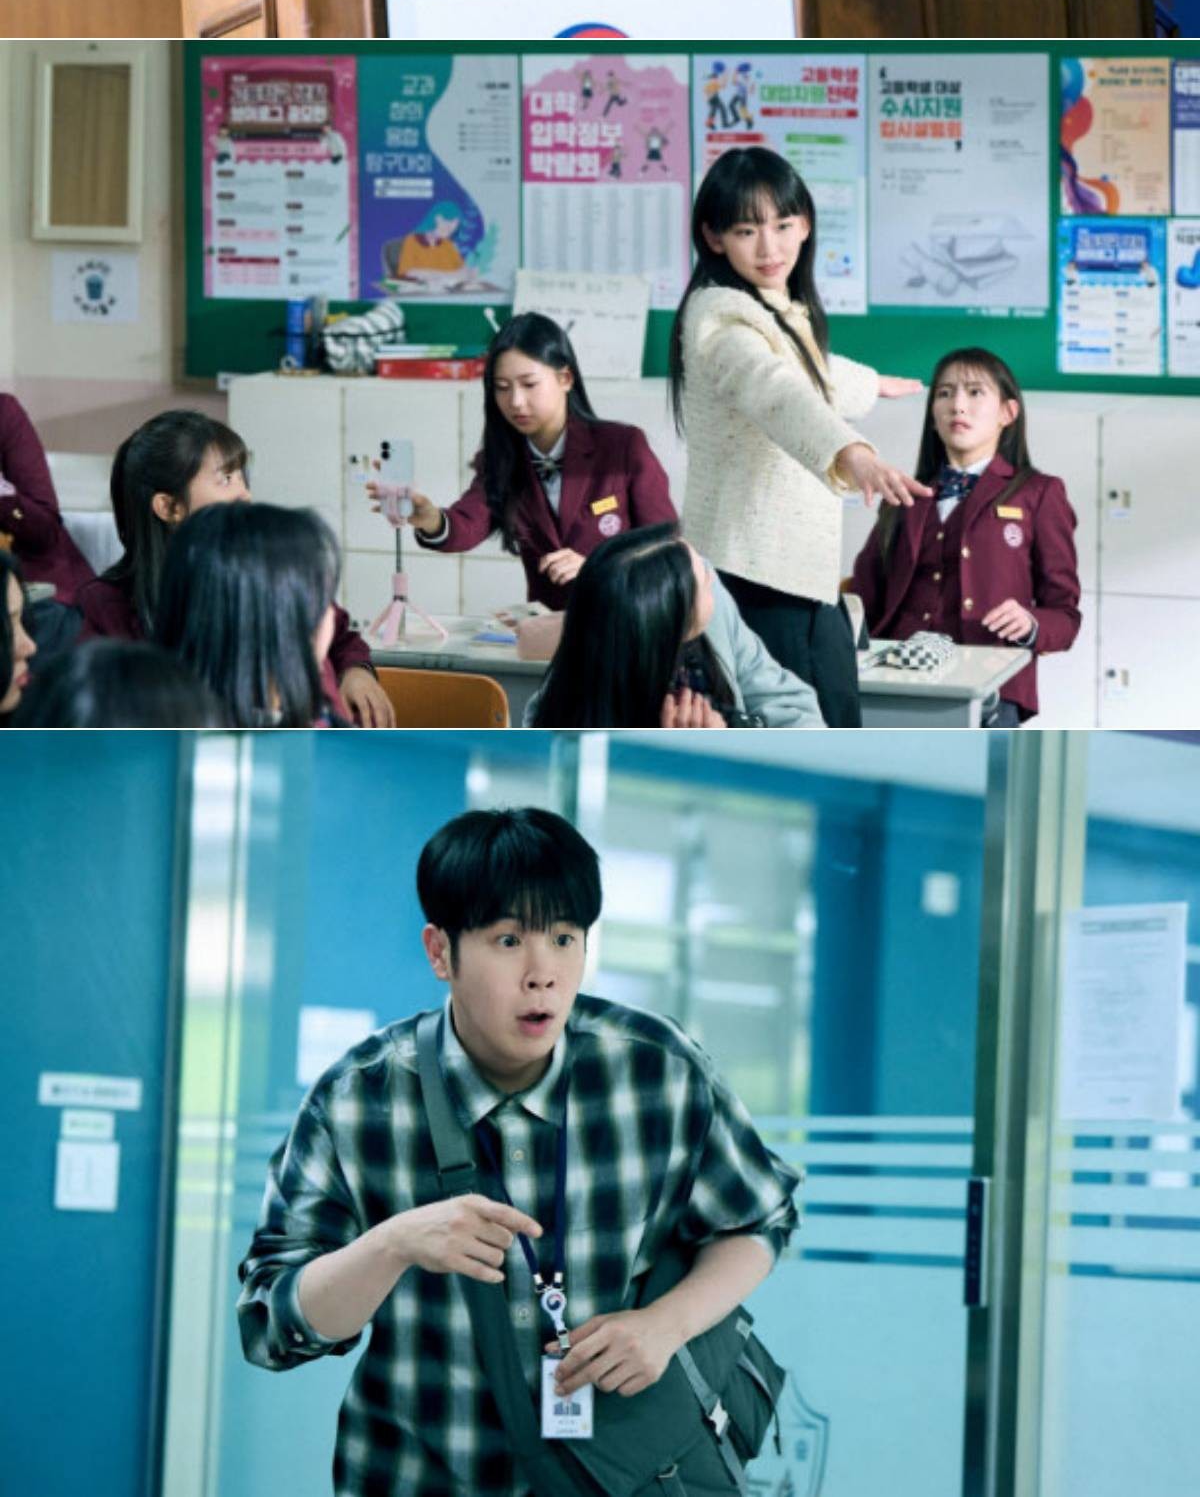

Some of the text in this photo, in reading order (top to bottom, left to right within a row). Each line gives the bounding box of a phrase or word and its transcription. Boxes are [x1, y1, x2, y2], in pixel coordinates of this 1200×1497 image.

[802, 67, 859, 83] 고등학생
[880, 81, 962, 95] 고등학생 대상
[531, 91, 576, 117] 대학
[881, 98, 962, 118] 수시지원
[531, 121, 623, 148] 입학정보
[880, 121, 962, 139] 입시설명회
[531, 152, 600, 178] 박람회
